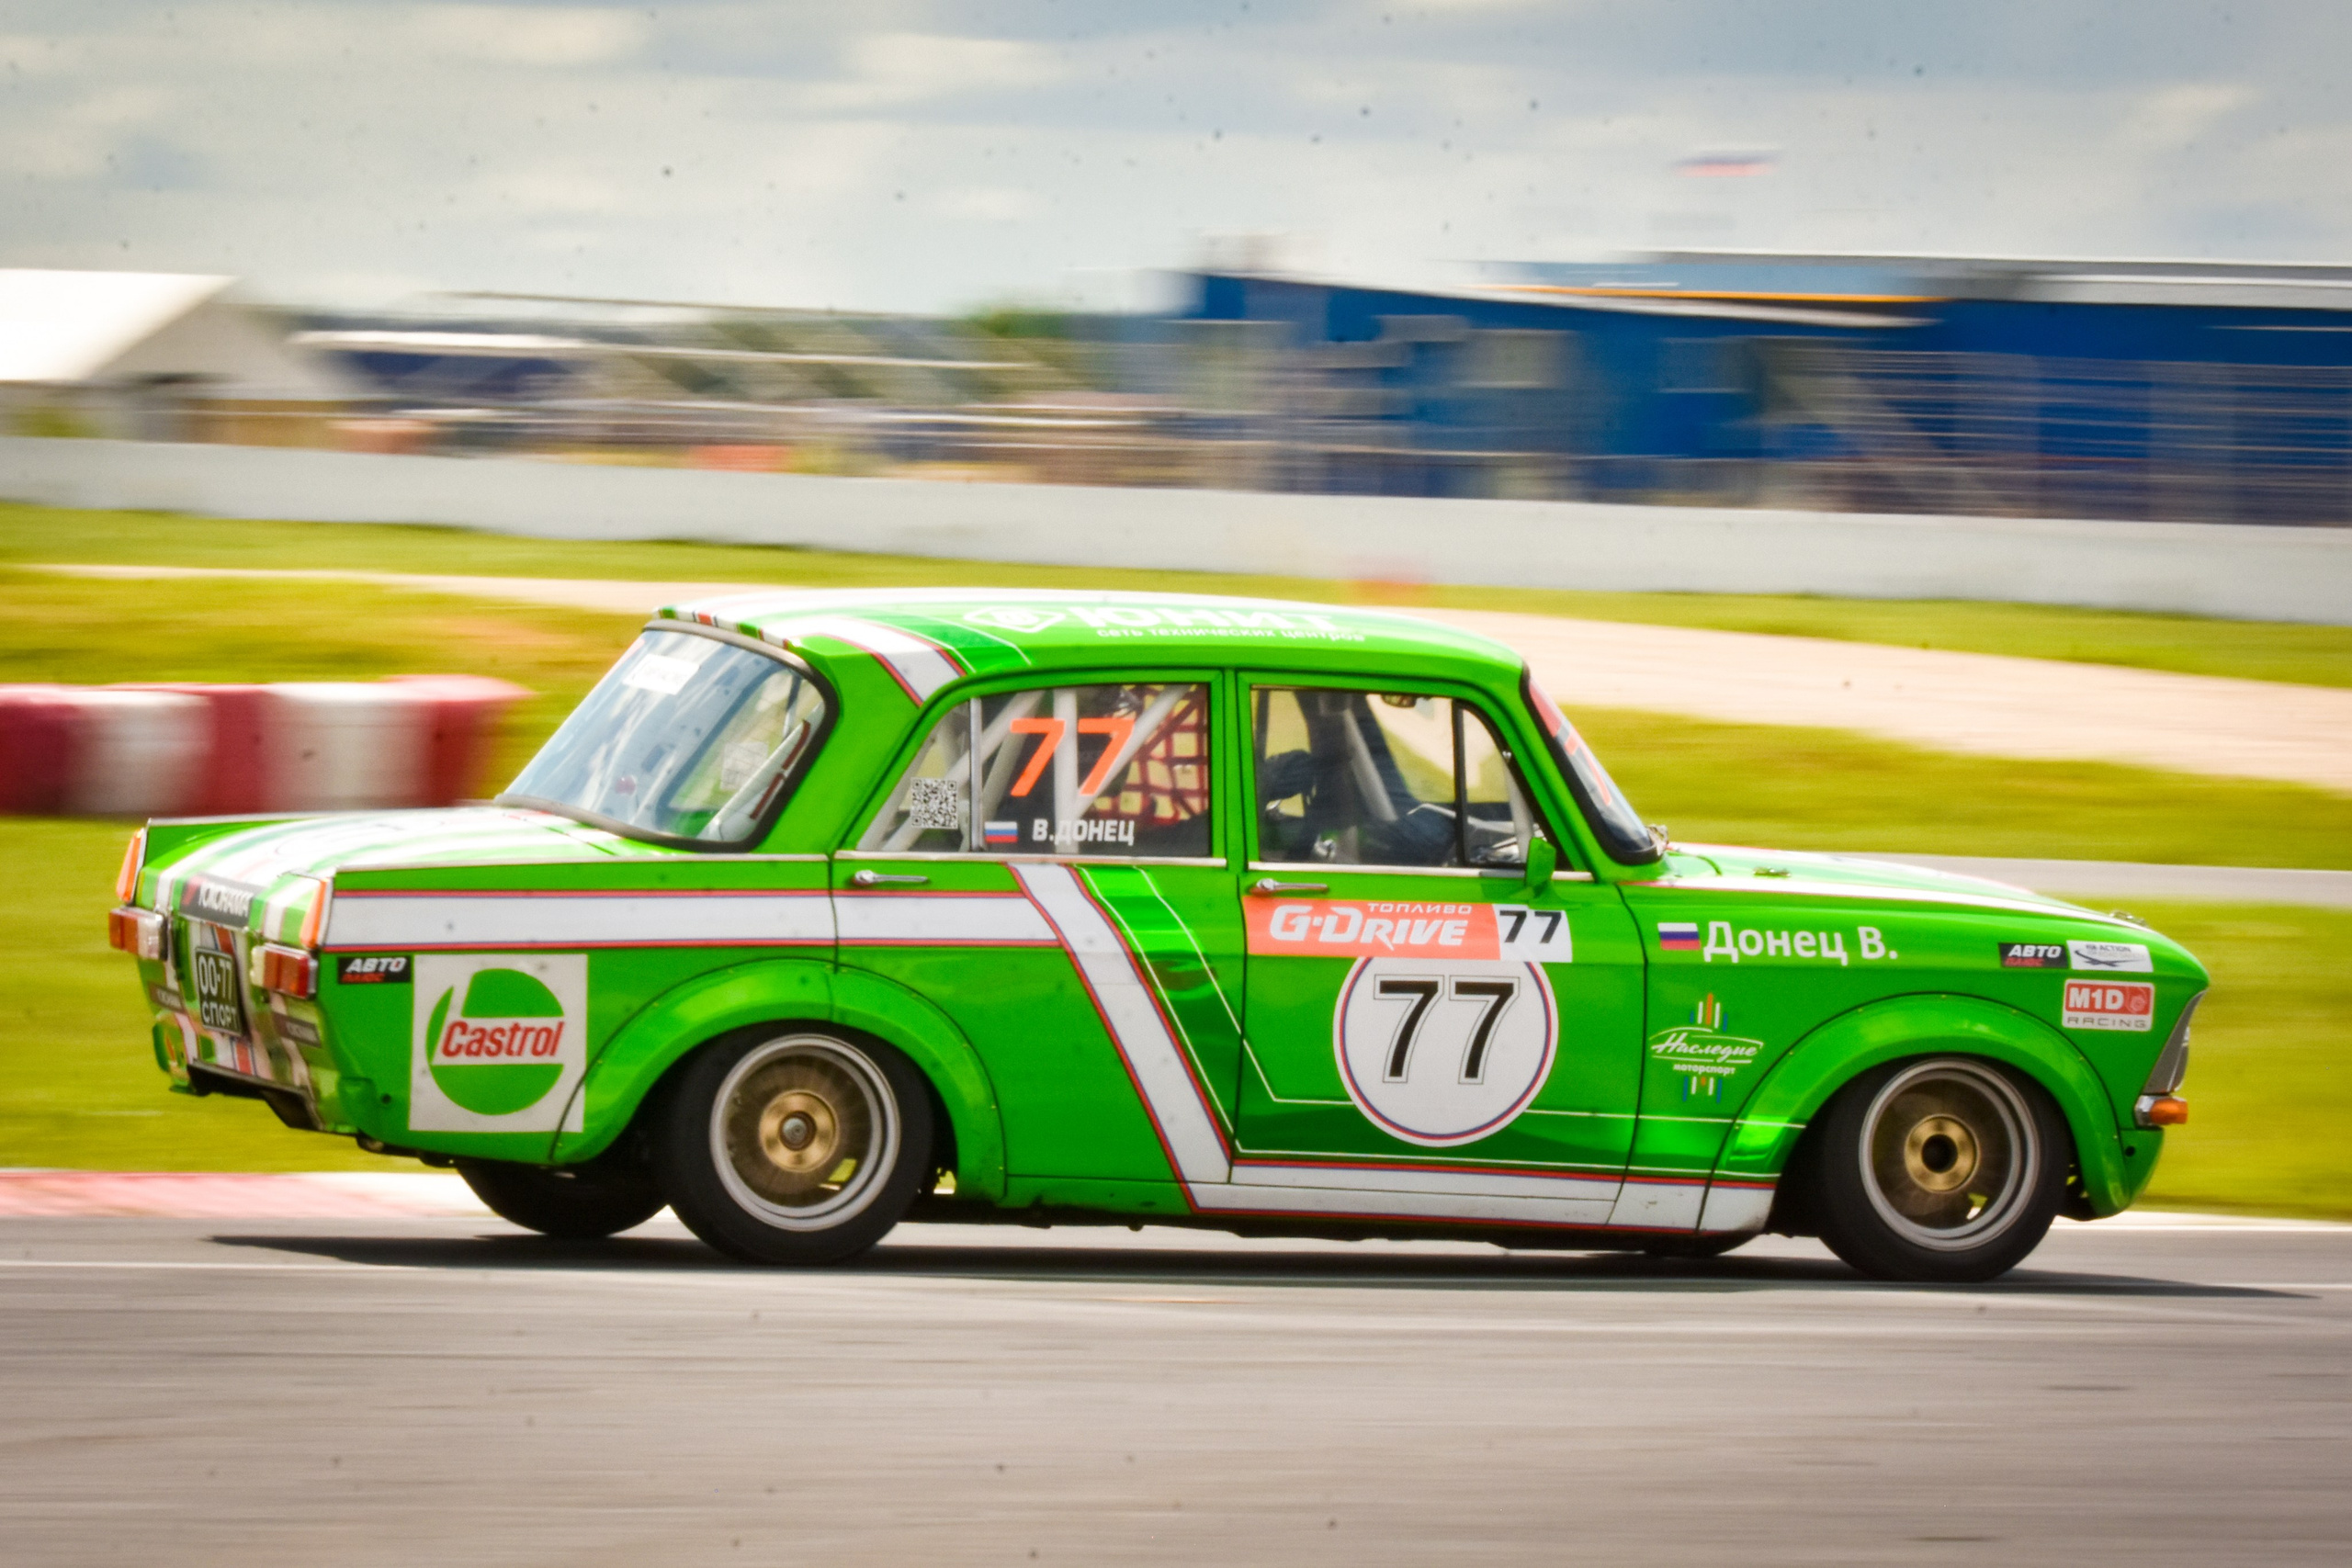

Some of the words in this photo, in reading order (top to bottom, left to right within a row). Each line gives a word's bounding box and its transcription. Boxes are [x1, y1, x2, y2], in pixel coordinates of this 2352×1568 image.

[1066, 606, 1339, 631] ЮНИТ
[1096, 627, 1145, 637] сеть
[1149, 628, 1276, 638] технических
[1281, 629, 1366, 642] центров
[1011, 717, 1136, 797] 77
[1367, 903, 1472, 915] ТОПЛИВО
[1498, 909, 1562, 944] 77
[1702, 920, 1849, 966] Донец
[1858, 925, 1899, 961] В.
[2007, 944, 2063, 958] АВТО
[345, 957, 407, 973] АВТО
[2068, 987, 2125, 1010] M1D
[1373, 973, 1521, 1086] 77
[2067, 1016, 2147, 1029] RACING
[441, 1021, 565, 1058] Castrol
[1672, 1064, 1736, 1077] моторспорт
